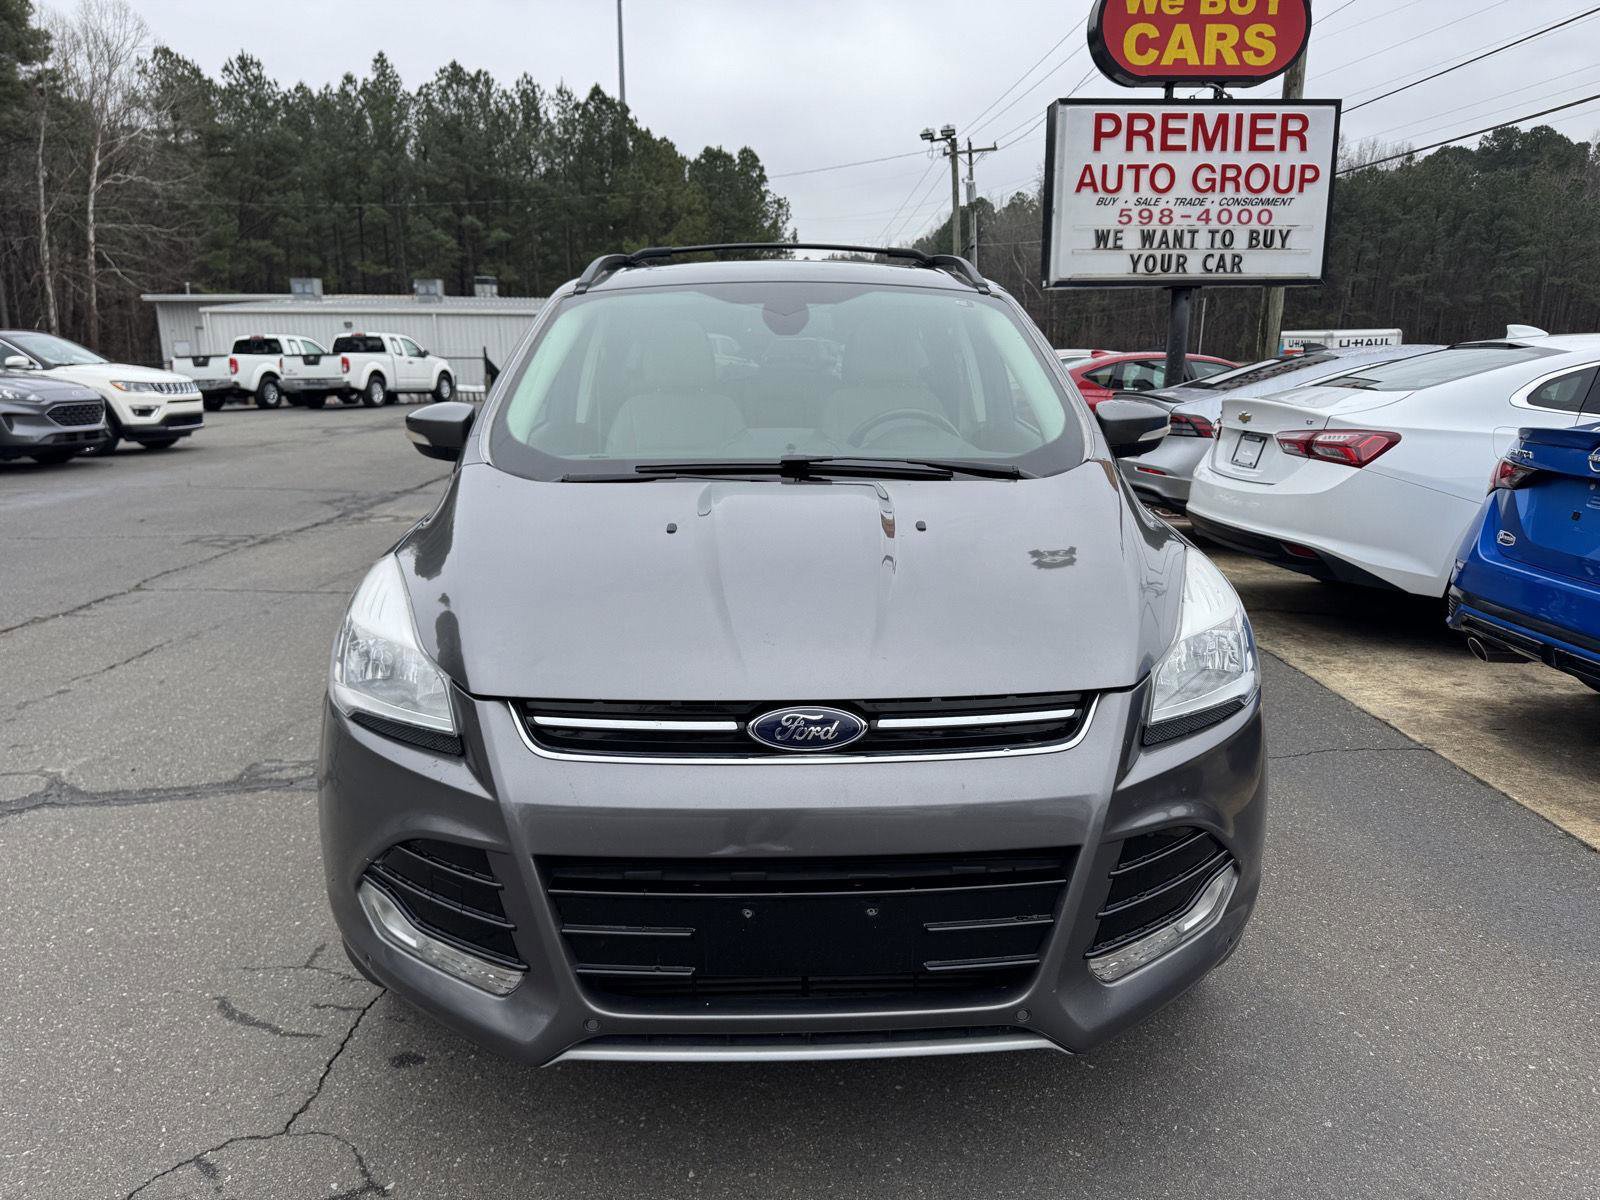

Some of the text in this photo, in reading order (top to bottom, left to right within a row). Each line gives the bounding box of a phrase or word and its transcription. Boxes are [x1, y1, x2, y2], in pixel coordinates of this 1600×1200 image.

[1123, 22, 1277, 66] CARS
[1092, 112, 1310, 152] PREMIER
[1074, 163, 1320, 194] AUTO GROUP
[1096, 197, 1295, 206] BUY SALE TRADE CONSIGNMENT
[1117, 208, 1274, 225] 598-4000
[1094, 229, 1291, 249] WE WANT TO BUY
[1129, 253, 1243, 273] YOUR CAR
[1339, 338, 1392, 348] U-HAUL
[774, 713, 840, 741] Ford
